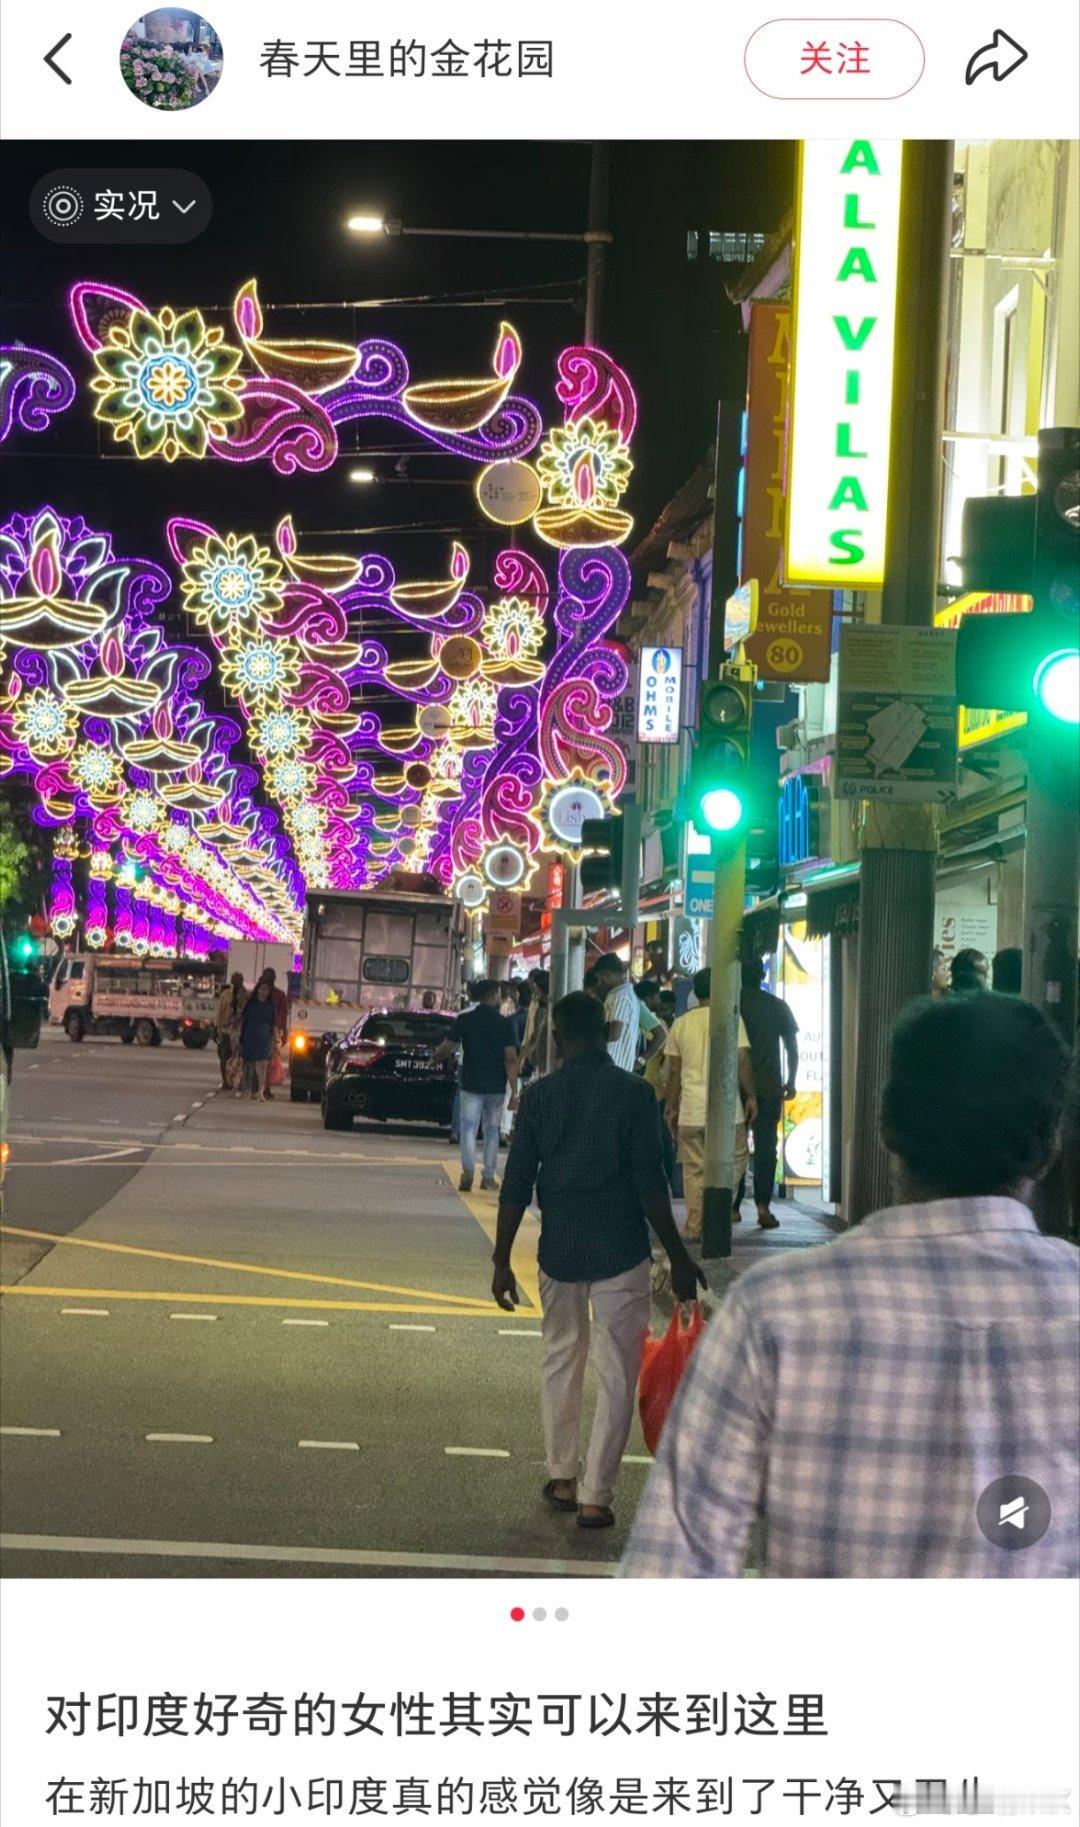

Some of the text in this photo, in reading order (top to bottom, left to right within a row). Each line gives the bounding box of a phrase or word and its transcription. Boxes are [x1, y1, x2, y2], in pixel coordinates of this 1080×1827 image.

[829, 315, 878, 565] VILAS
[767, 602, 806, 617] Gold
[757, 620, 823, 635] ewellers
[770, 645, 801, 664] 80
[643, 675, 658, 731] OHMS
[664, 676, 677, 733] MOBILE
[859, 784, 895, 795] POLICE
[689, 897, 714, 913] ONE
